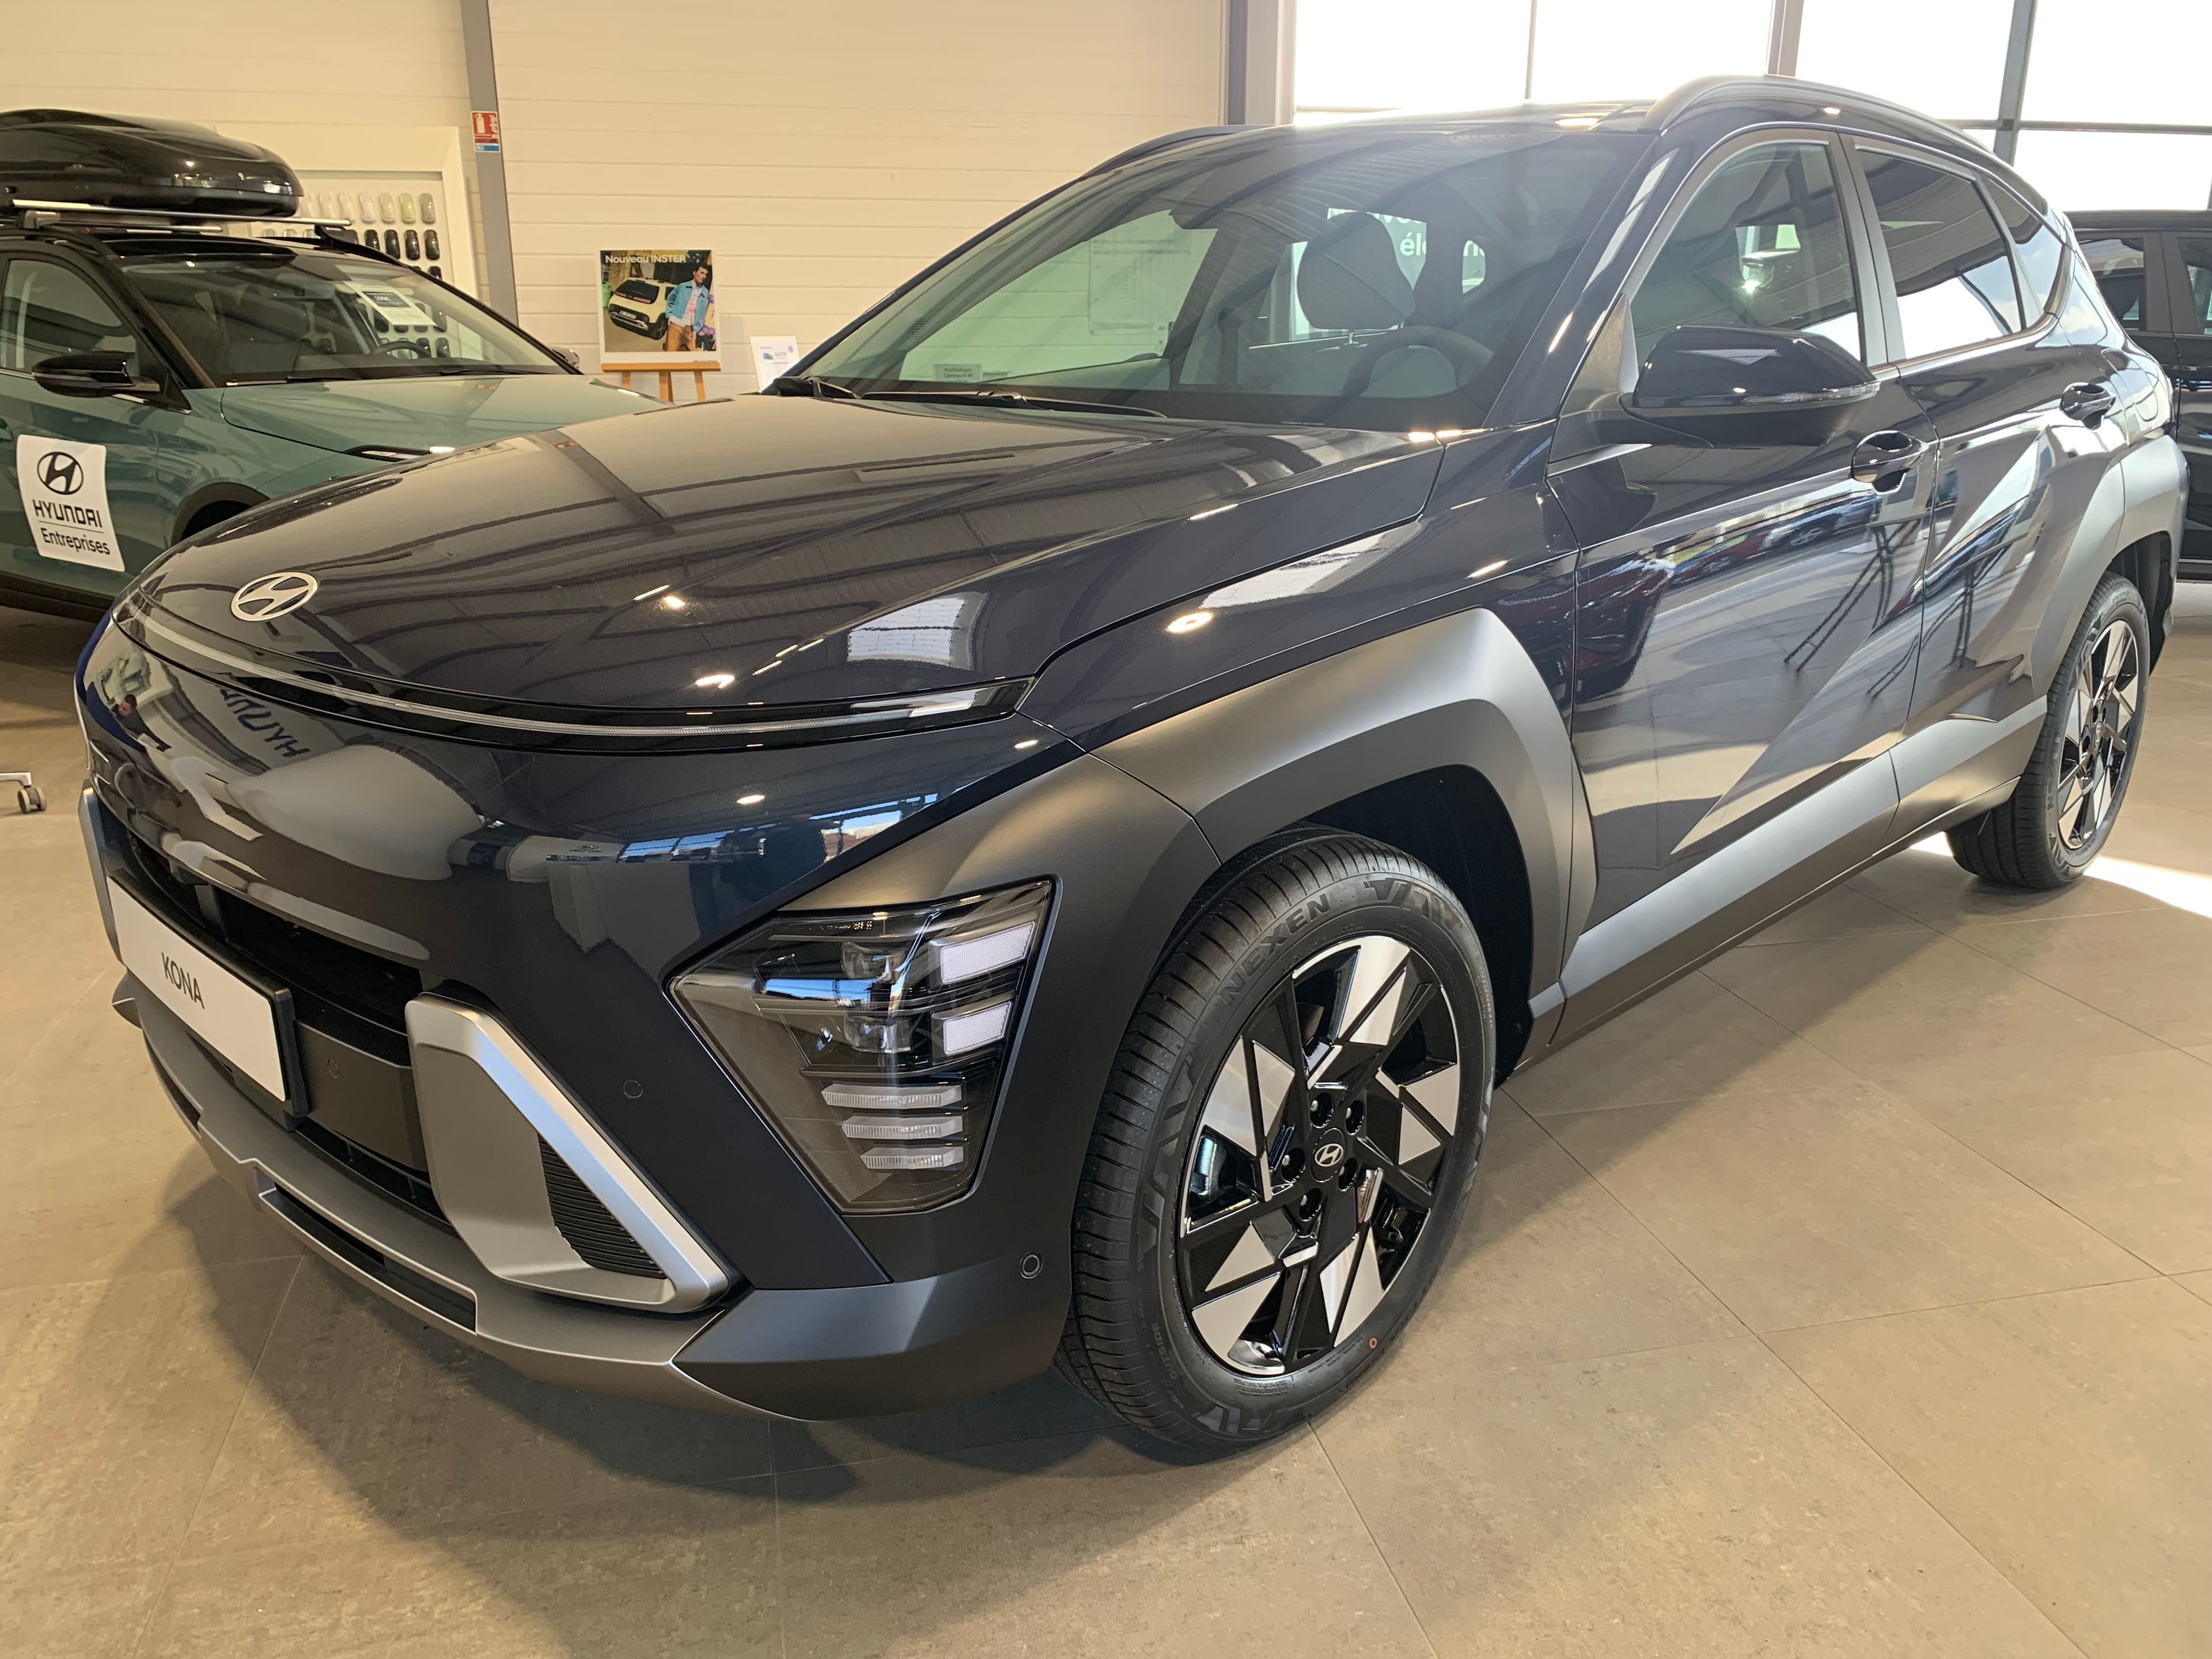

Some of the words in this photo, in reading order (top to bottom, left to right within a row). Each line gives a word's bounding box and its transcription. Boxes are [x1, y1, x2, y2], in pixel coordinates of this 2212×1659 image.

[605, 255, 649, 263] Nouveau
[651, 255, 687, 263] INSTER
[32, 499, 103, 528] HYUNDAI
[40, 527, 110, 555] Entreprises
[1219, 893, 1330, 1008] NEXEN
[161, 952, 205, 1010] KONA
[1152, 1322, 1178, 1380] OUTSIDE
